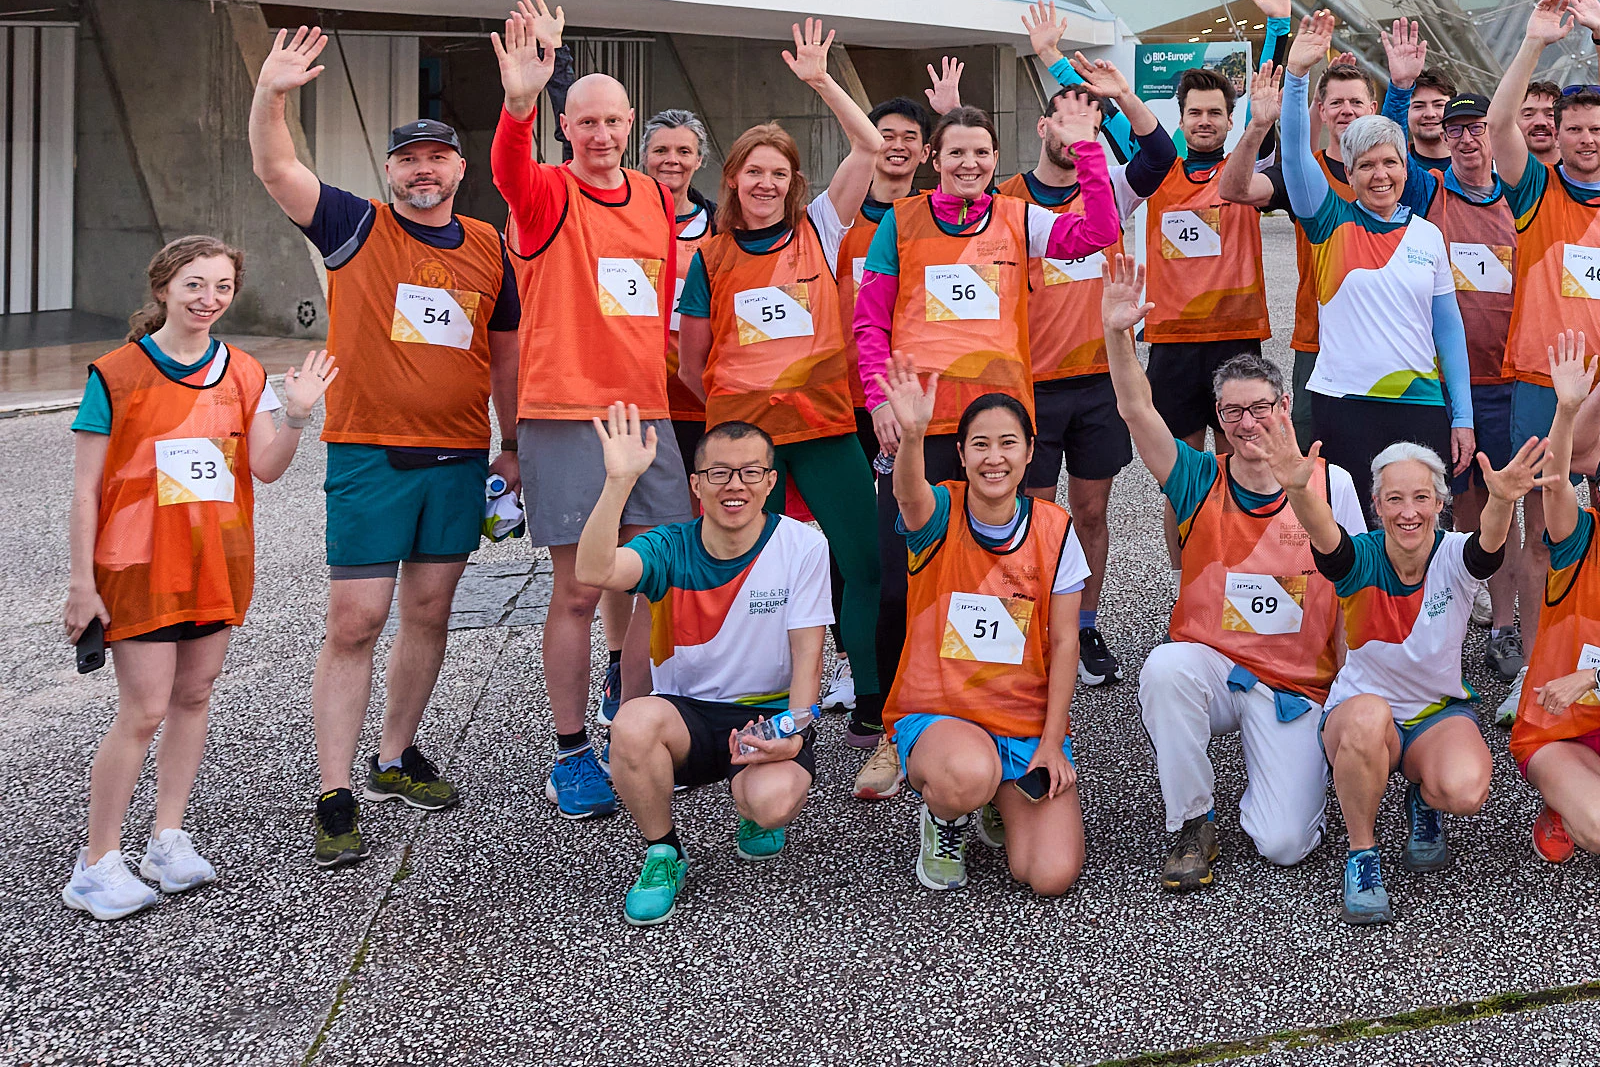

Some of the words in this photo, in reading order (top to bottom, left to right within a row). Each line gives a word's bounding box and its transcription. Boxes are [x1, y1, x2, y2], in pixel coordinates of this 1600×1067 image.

[1178, 227, 1199, 242] 45
[1477, 261, 1485, 275] 1
[627, 279, 637, 296] 3
[951, 284, 976, 301] 56
[423, 307, 451, 326] 54
[761, 304, 786, 323] 55
[191, 461, 217, 480] 53
[750, 590, 768, 598] Rise
[769, 589, 776, 597] &
[961, 604, 987, 612] IPSEN
[1251, 596, 1278, 614] 69
[973, 619, 999, 641] 51
